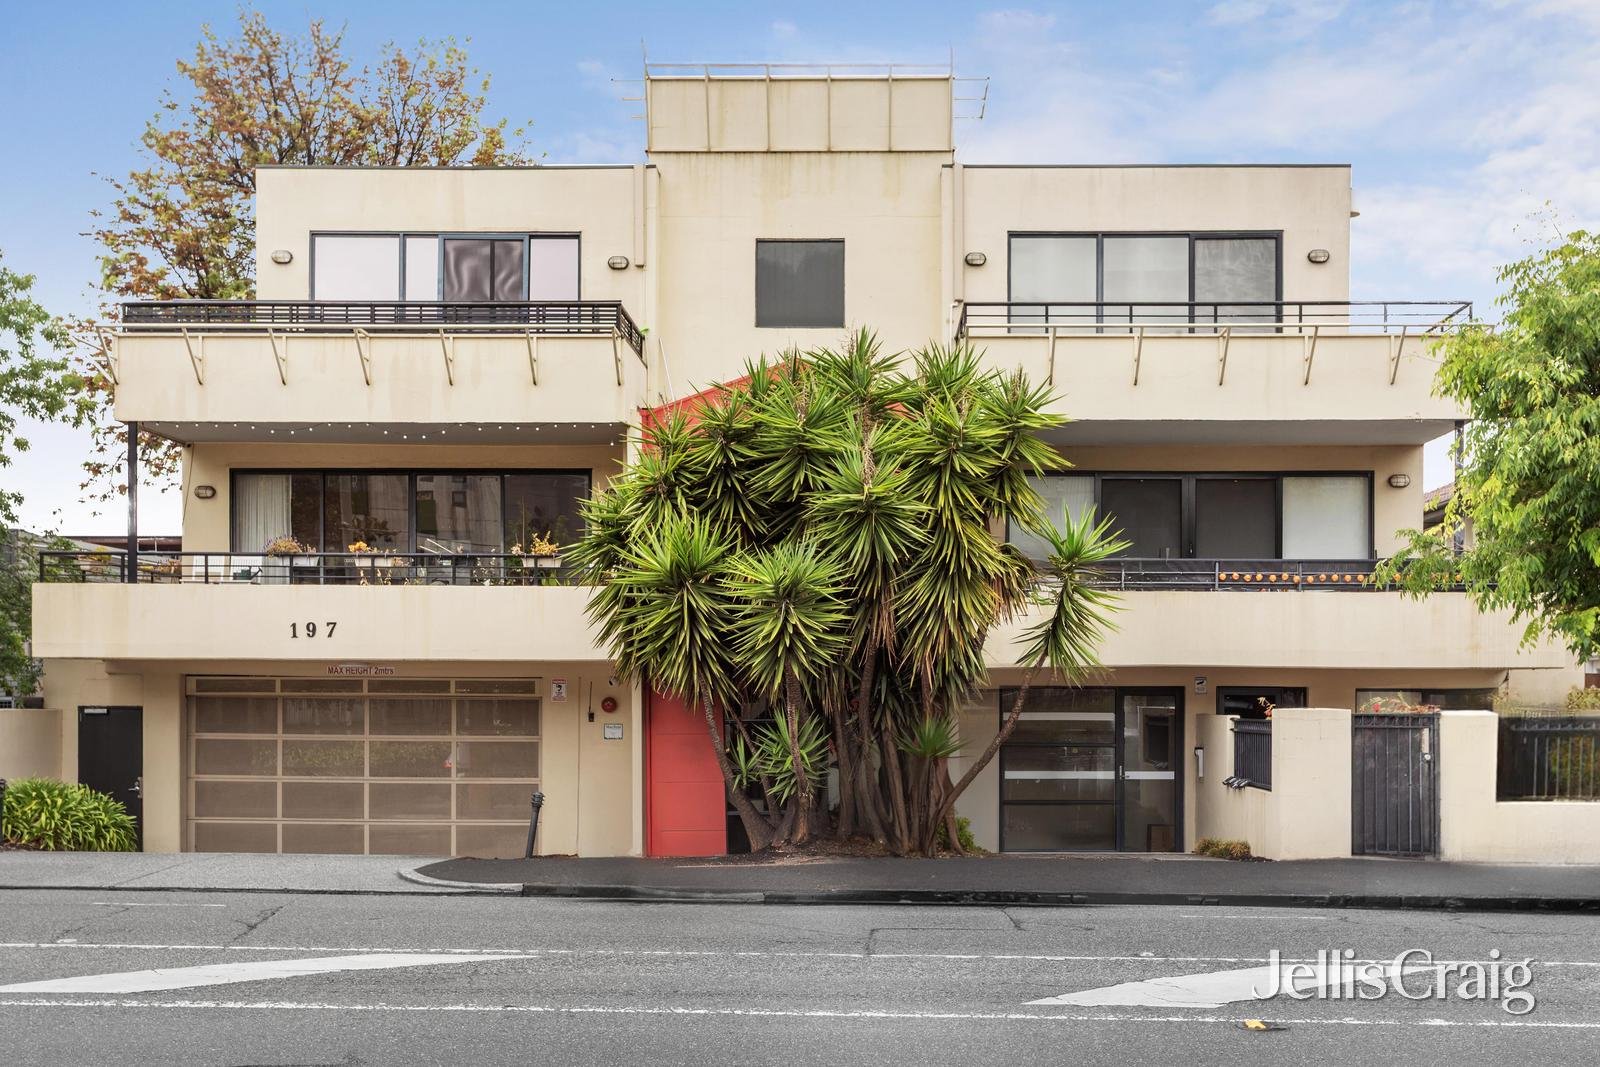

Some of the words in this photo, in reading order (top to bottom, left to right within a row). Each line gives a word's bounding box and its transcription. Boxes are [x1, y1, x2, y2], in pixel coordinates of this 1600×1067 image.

[290, 621, 337, 639] 197
[327, 666, 344, 675] MAX
[345, 666, 372, 675] HEIGHT
